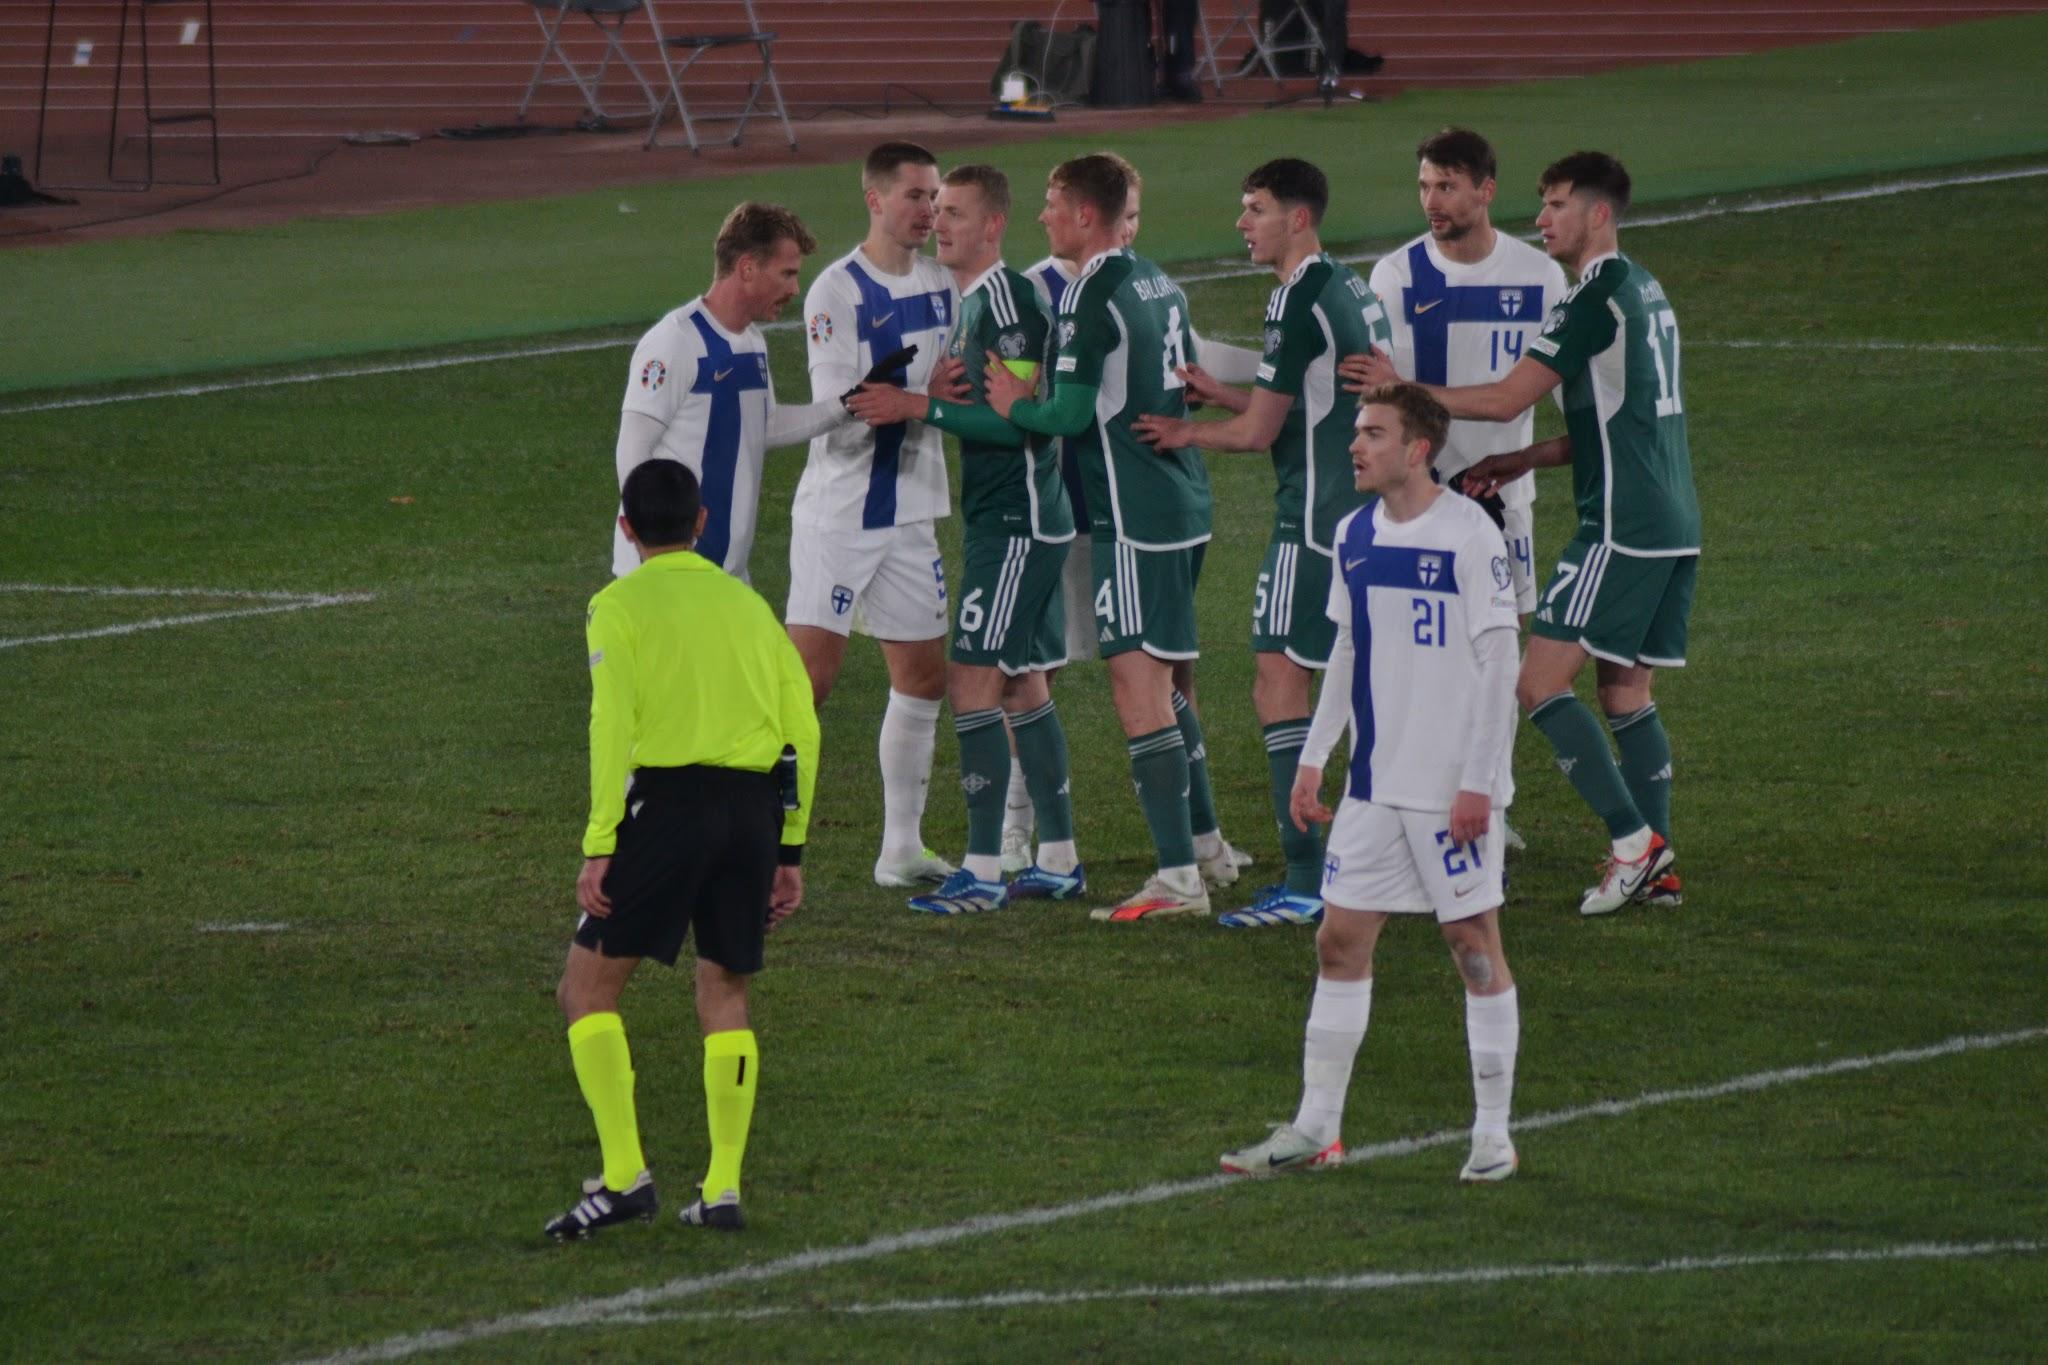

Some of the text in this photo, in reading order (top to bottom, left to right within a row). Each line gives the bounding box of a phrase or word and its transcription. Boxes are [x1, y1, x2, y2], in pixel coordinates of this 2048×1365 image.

[1490, 330, 1523, 372] 14
[1646, 309, 1682, 418] 17
[960, 588, 984, 632] 6
[1094, 578, 1116, 623] 4
[1252, 573, 1270, 618] 5
[1412, 598, 1446, 647] 21
[1434, 828, 1483, 877] 21
